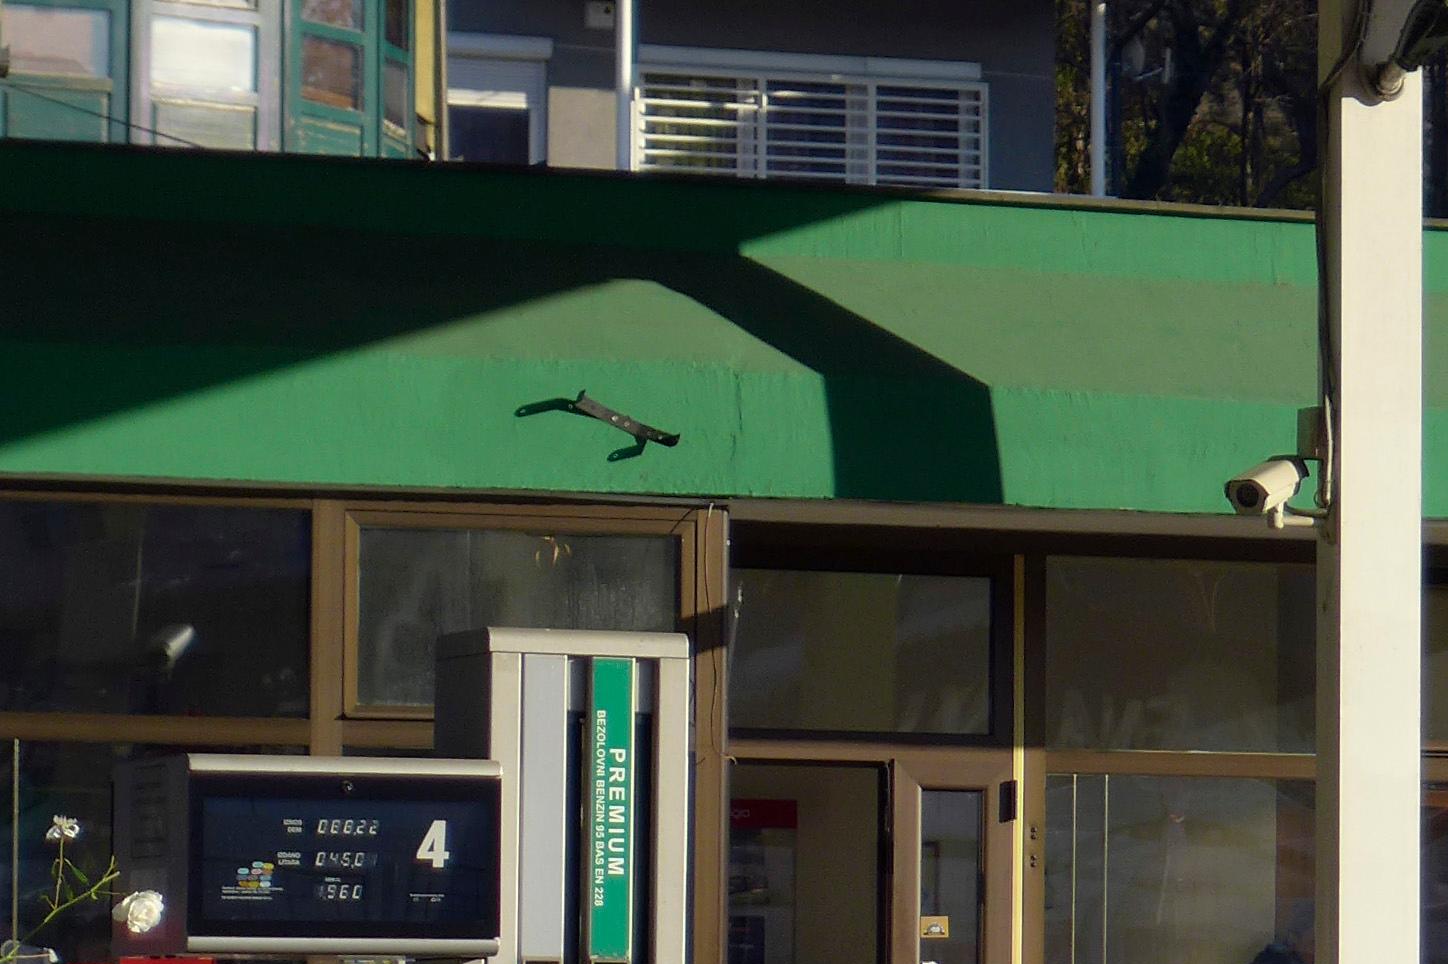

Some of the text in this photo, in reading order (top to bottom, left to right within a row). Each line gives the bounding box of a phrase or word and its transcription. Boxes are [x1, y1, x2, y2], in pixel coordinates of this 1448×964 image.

[595, 709, 607, 776] BEZOLOVNI
[595, 779, 606, 822] BENZIN
[607, 748, 627, 875] PREMIUM
[416, 819, 450, 868] 4
[594, 840, 605, 865] BAS
[595, 824, 605, 838] 95
[594, 867, 605, 884] EN
